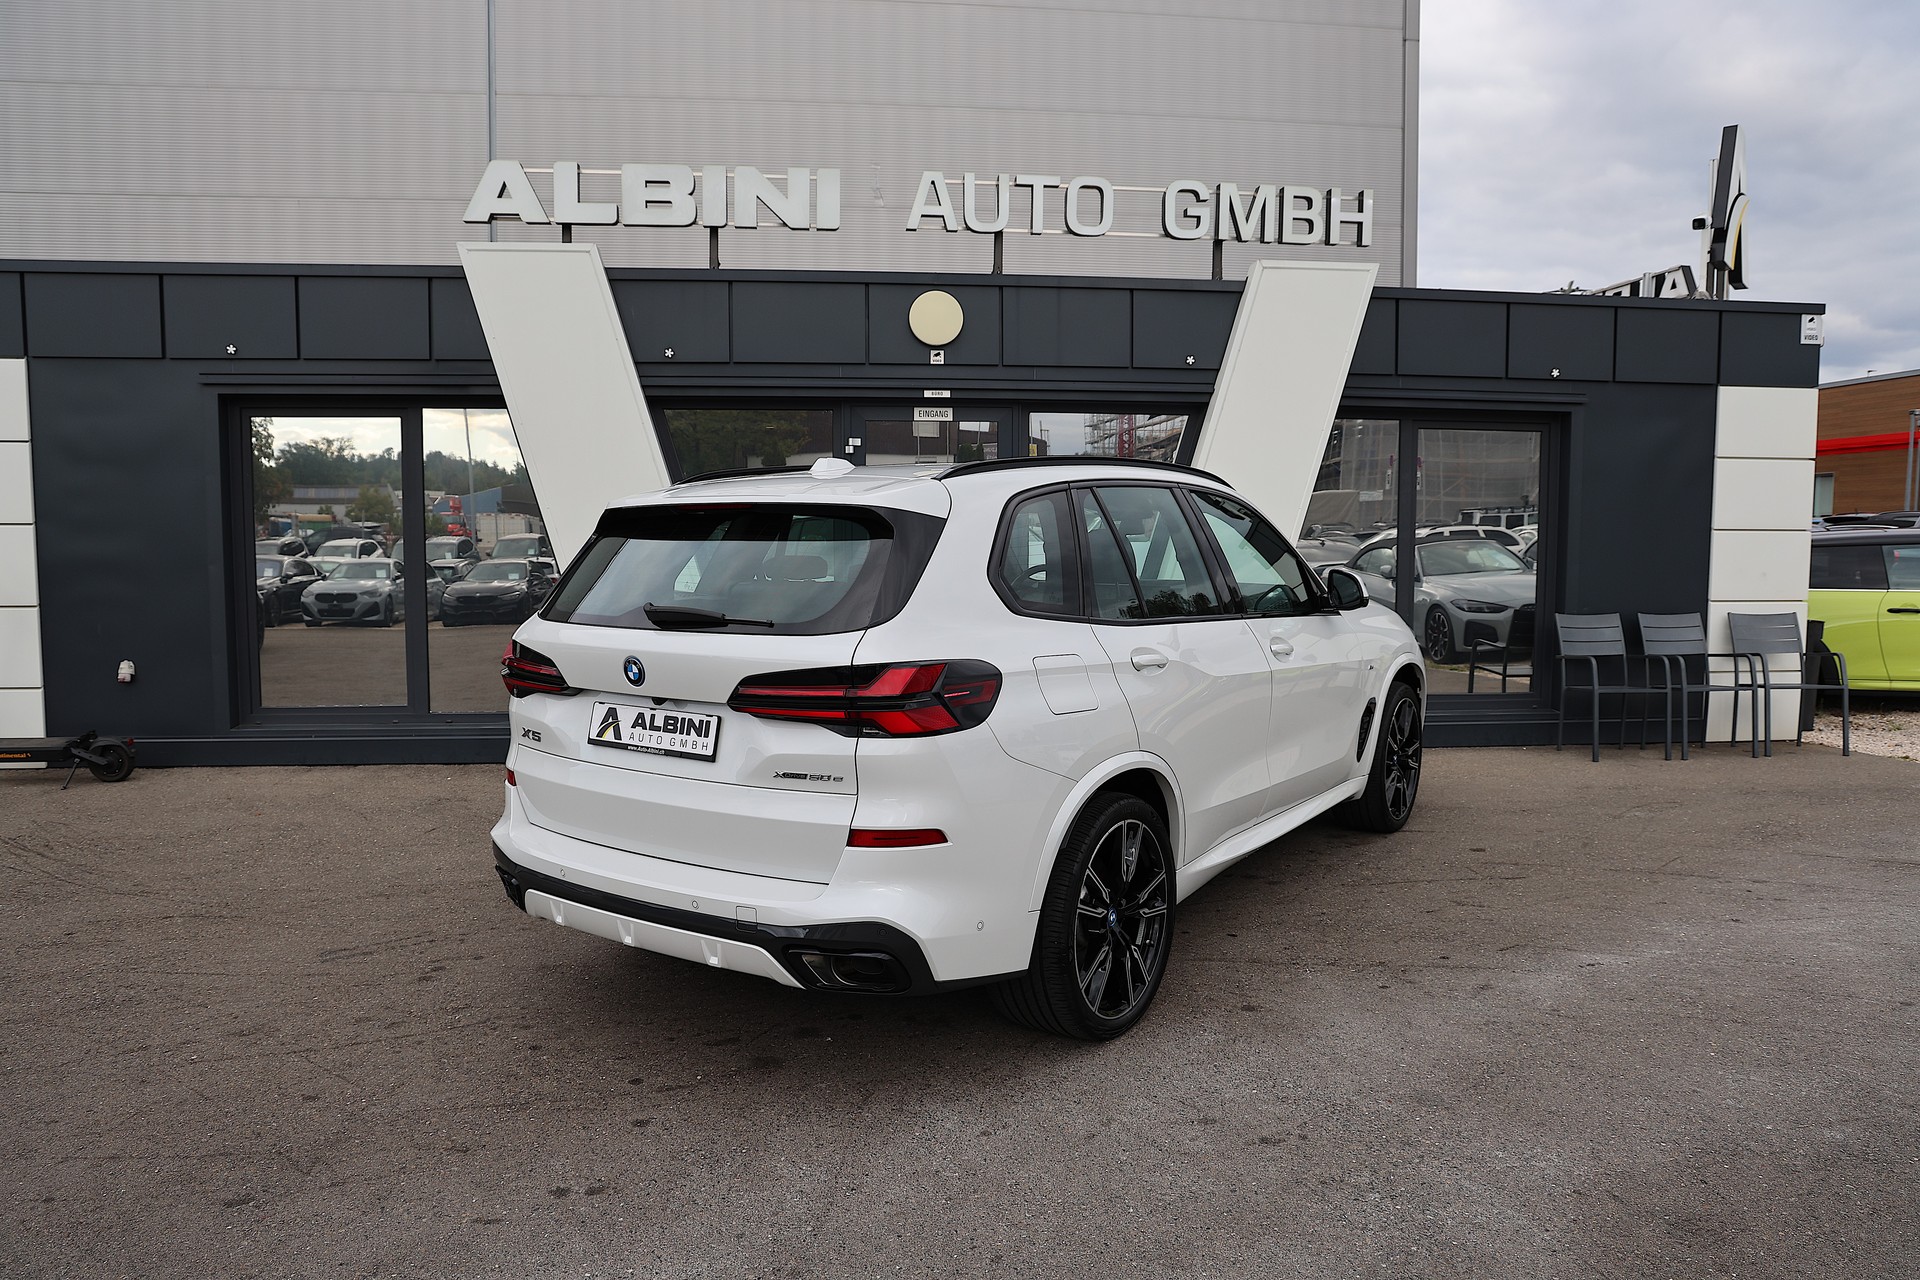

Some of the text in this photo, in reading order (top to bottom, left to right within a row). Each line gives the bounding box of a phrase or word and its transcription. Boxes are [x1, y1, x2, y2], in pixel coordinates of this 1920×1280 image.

[462, 159, 1374, 248] ALBINI AUTO GMBH
[918, 409, 949, 418] EINGANG
[521, 726, 541, 742] X5
[630, 711, 712, 739] ALBINI
[628, 732, 709, 751] AUTO GMBH
